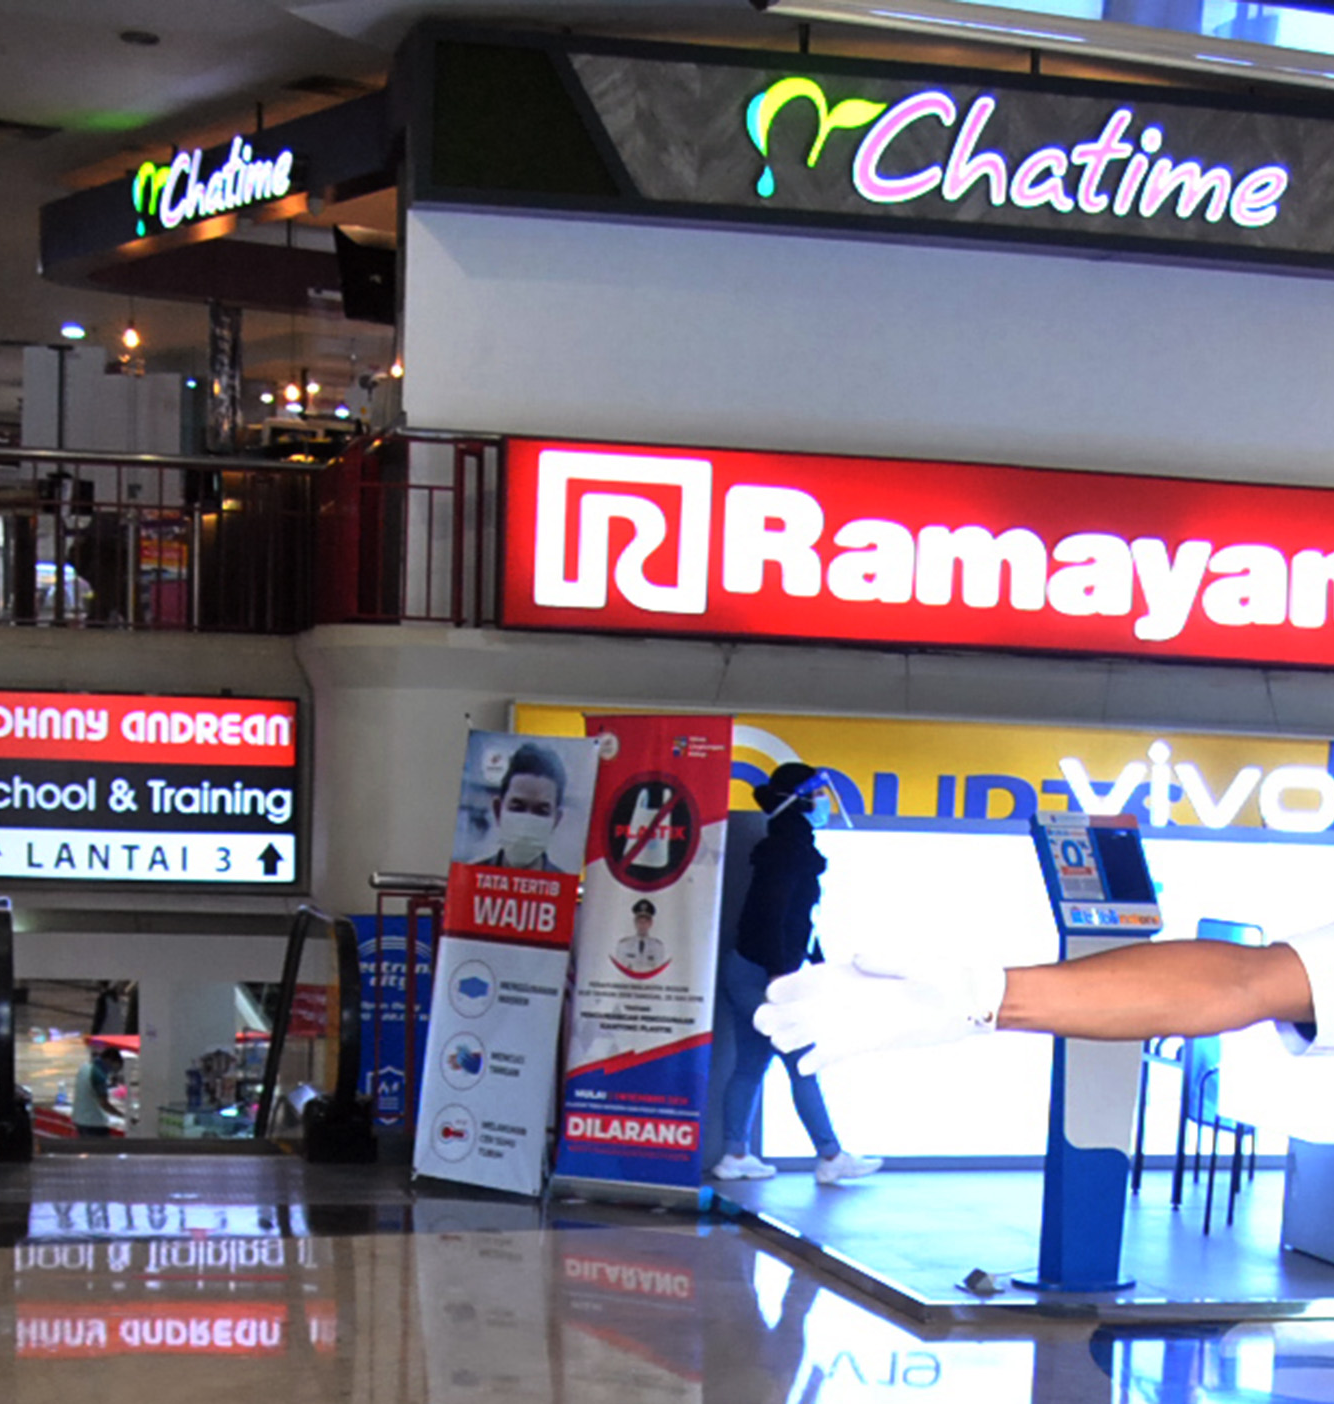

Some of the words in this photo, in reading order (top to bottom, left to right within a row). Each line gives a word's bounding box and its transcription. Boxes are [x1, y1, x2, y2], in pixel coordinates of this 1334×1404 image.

[850, 90, 1291, 228] Chatime
[159, 135, 294, 229] Chatime
[108, 778, 138, 812] &
[147, 780, 293, 824] Training
[27, 842, 188, 871] LANTAI
[215, 847, 232, 872] 3
[475, 872, 509, 891] TATA
[512, 876, 561, 897] TERTIB
[473, 896, 557, 933] WAJIB
[567, 1116, 694, 1146] DILARANG
